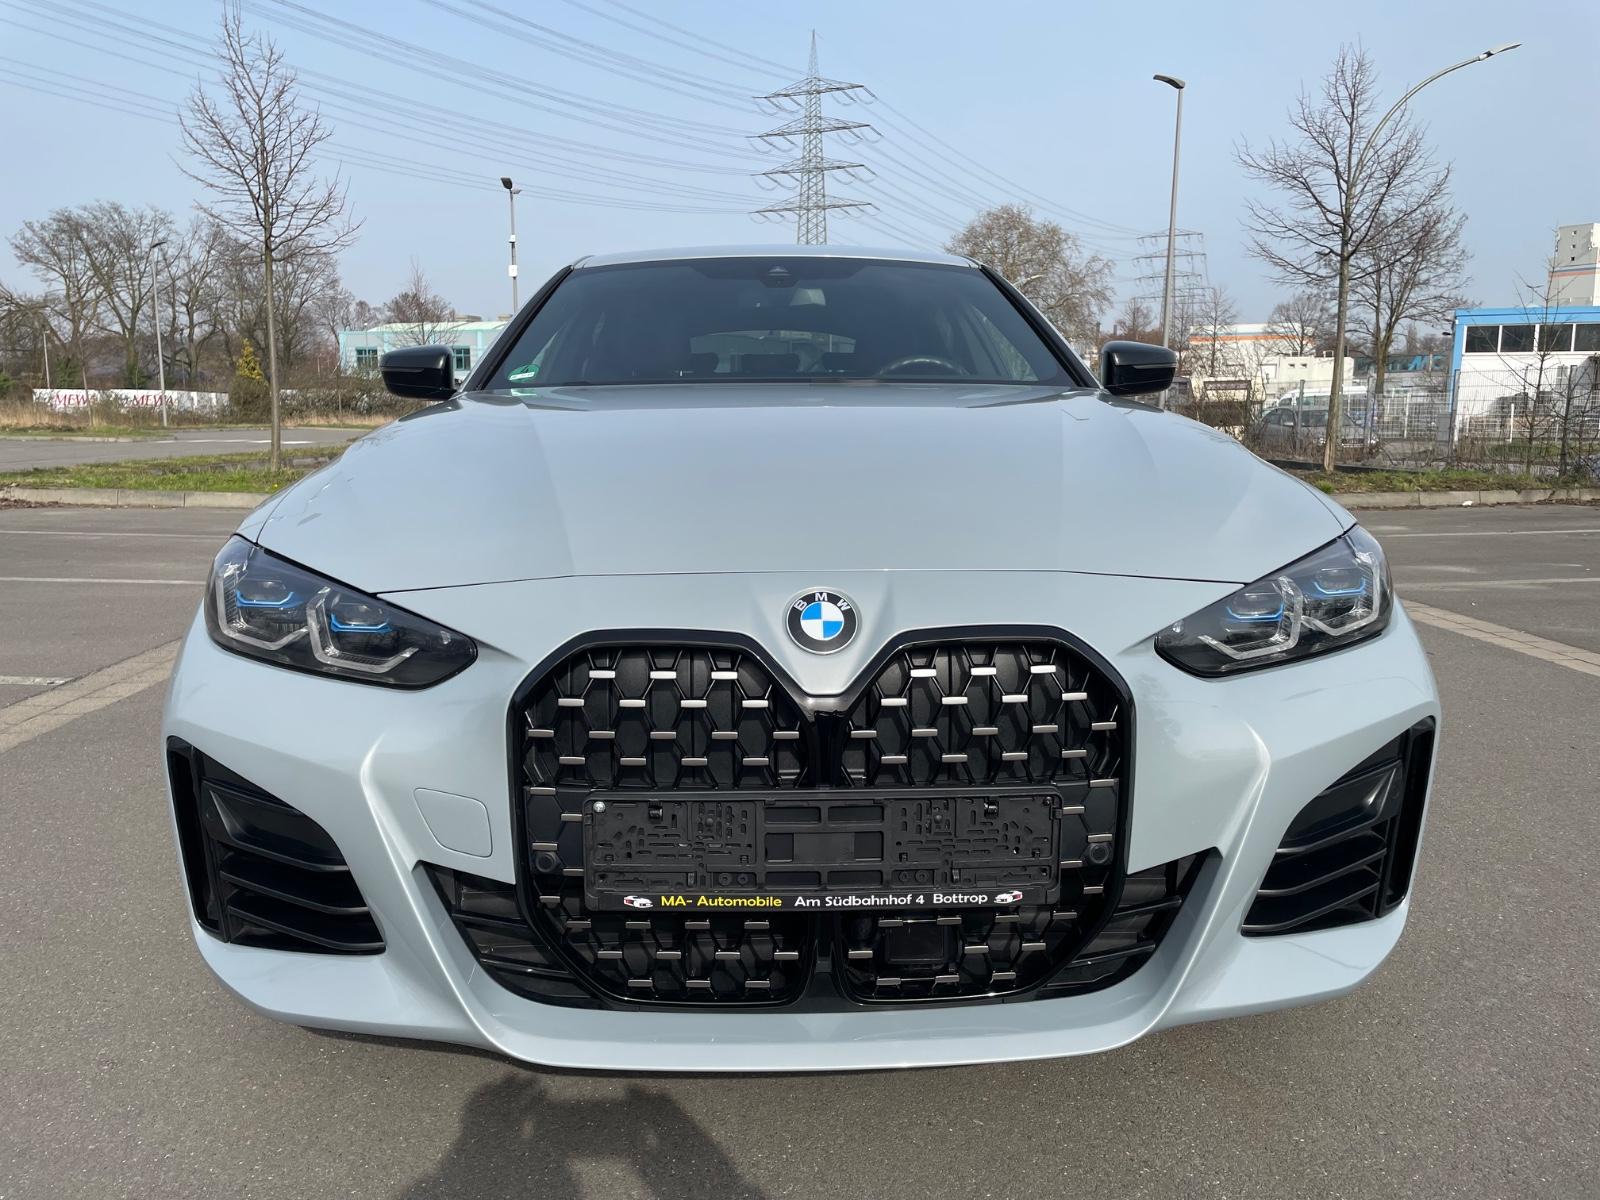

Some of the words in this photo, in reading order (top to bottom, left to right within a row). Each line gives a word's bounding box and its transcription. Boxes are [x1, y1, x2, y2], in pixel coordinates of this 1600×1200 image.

[794, 592, 851, 611] BMW
[661, 895, 693, 907] MA-
[697, 895, 782, 907] Automobile
[794, 896, 821, 907] Am
[825, 895, 912, 906] Südbahnhof
[916, 895, 925, 904] 4
[933, 893, 988, 905] Bottrop
